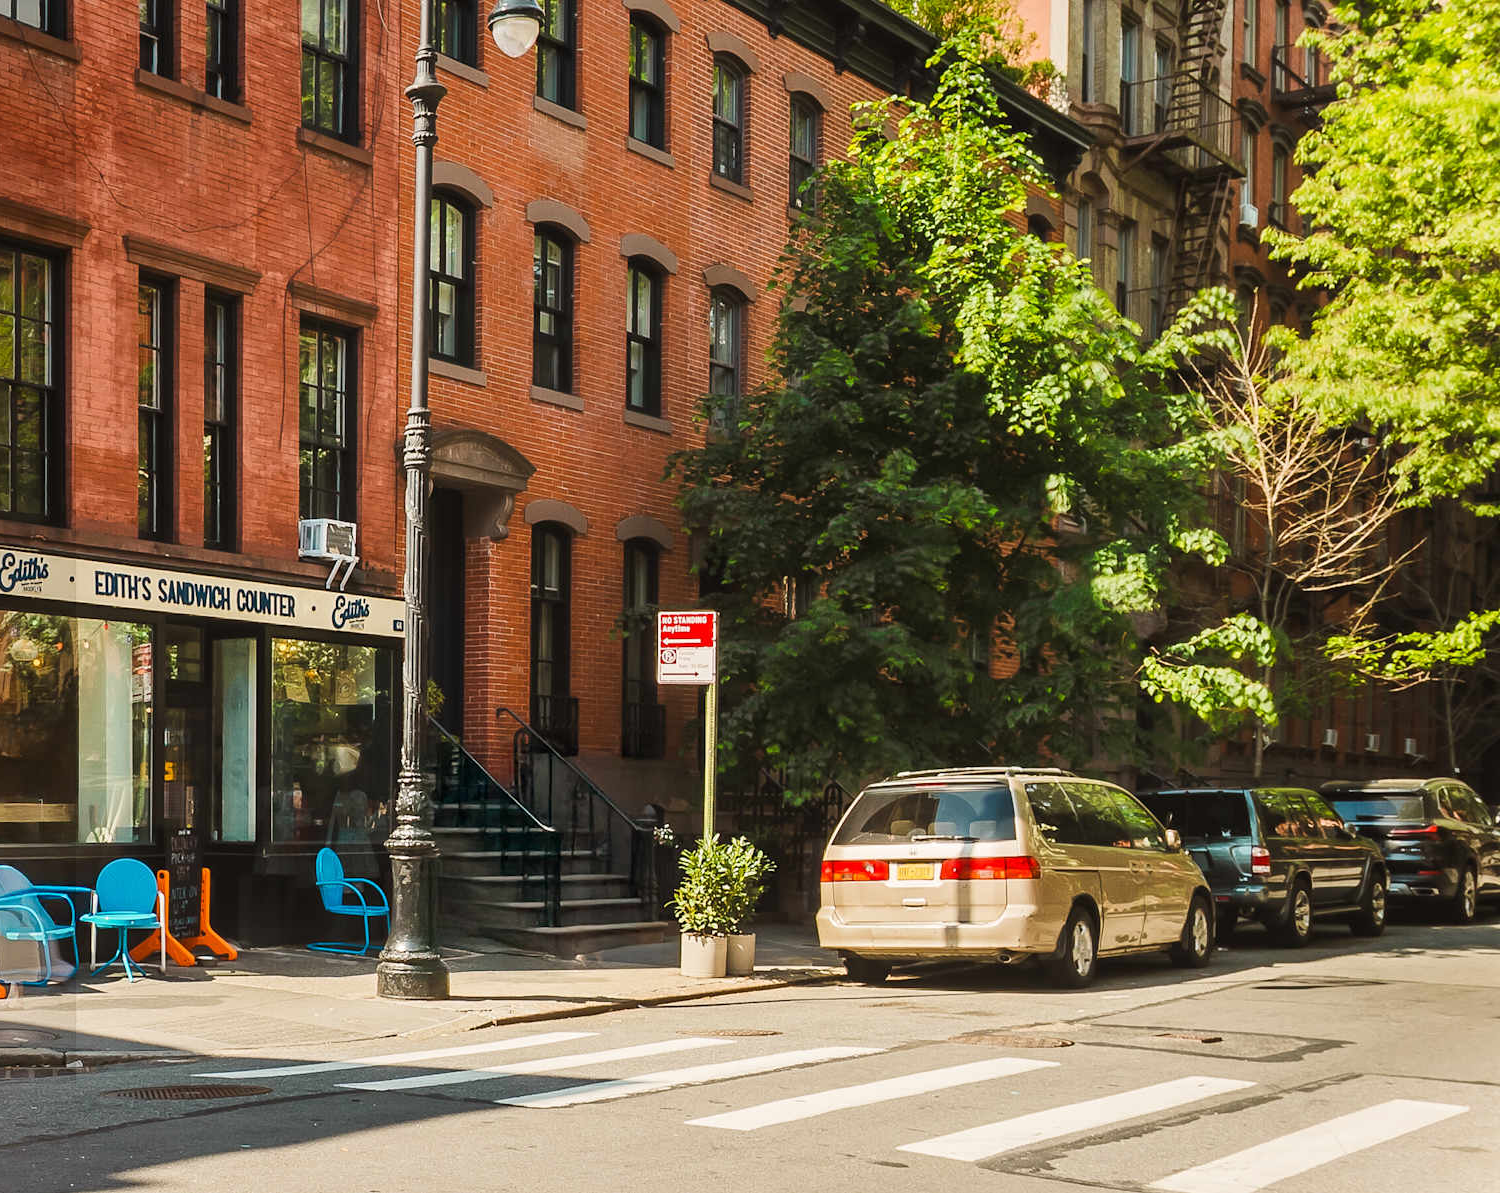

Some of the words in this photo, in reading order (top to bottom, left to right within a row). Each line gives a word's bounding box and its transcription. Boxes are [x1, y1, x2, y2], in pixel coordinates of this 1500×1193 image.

[94, 570, 151, 601] EDITH'S
[158, 578, 231, 611] SANDWICH
[237, 588, 296, 618] COUNTER
[332, 595, 370, 629] Edith's
[662, 615, 672, 624] NO
[673, 615, 708, 624] STANDING
[662, 625, 691, 634] Anytime
